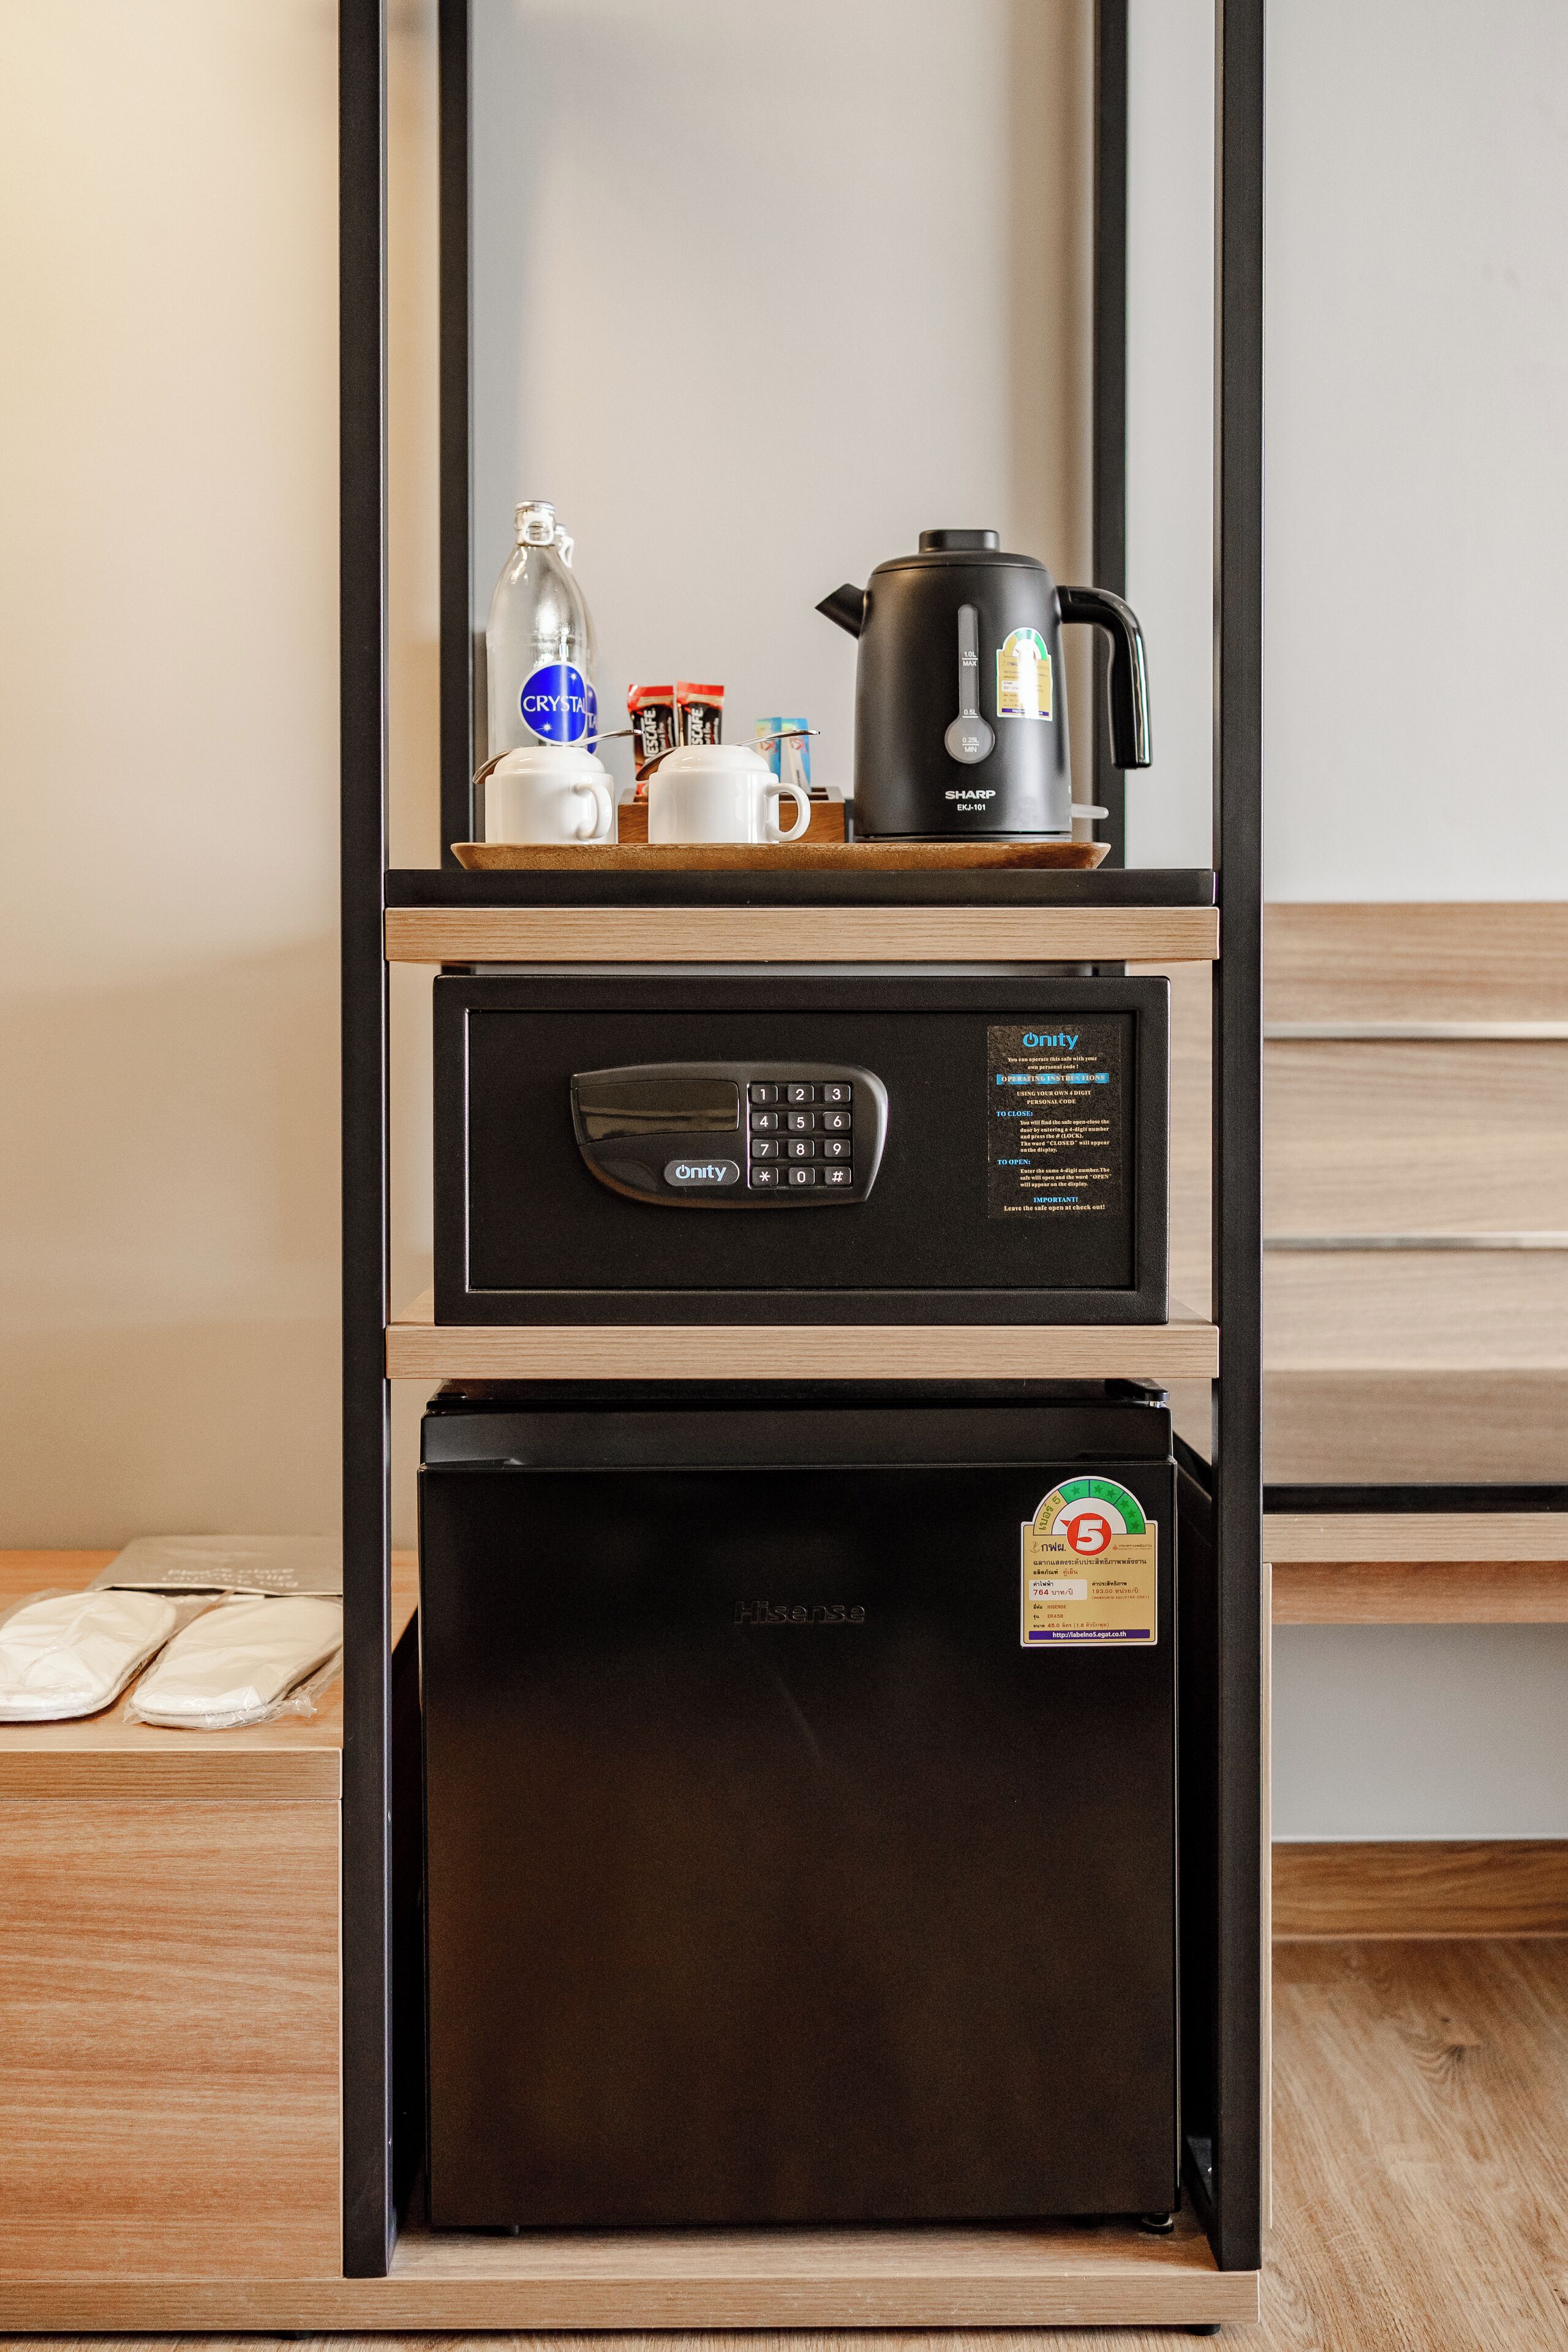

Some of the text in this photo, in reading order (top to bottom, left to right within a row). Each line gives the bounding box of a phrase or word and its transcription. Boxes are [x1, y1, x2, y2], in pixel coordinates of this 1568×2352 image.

[945, 790, 997, 799] SHARP
[1022, 1032, 1079, 1050] Onity
[760, 1088, 841, 1101] 1 2 3
[760, 1115, 842, 1128] 4 5 6
[760, 1143, 841, 1156] 7 8 9
[676, 1164, 727, 1182] Onity
[797, 1171, 806, 1183] 0
[832, 1171, 843, 1182] #
[1052, 1495, 1061, 1504] 5
[1076, 1520, 1104, 1551] 5
[1041, 1542, 1066, 1551] กฟผ.
[734, 1600, 865, 1623] Hisense
